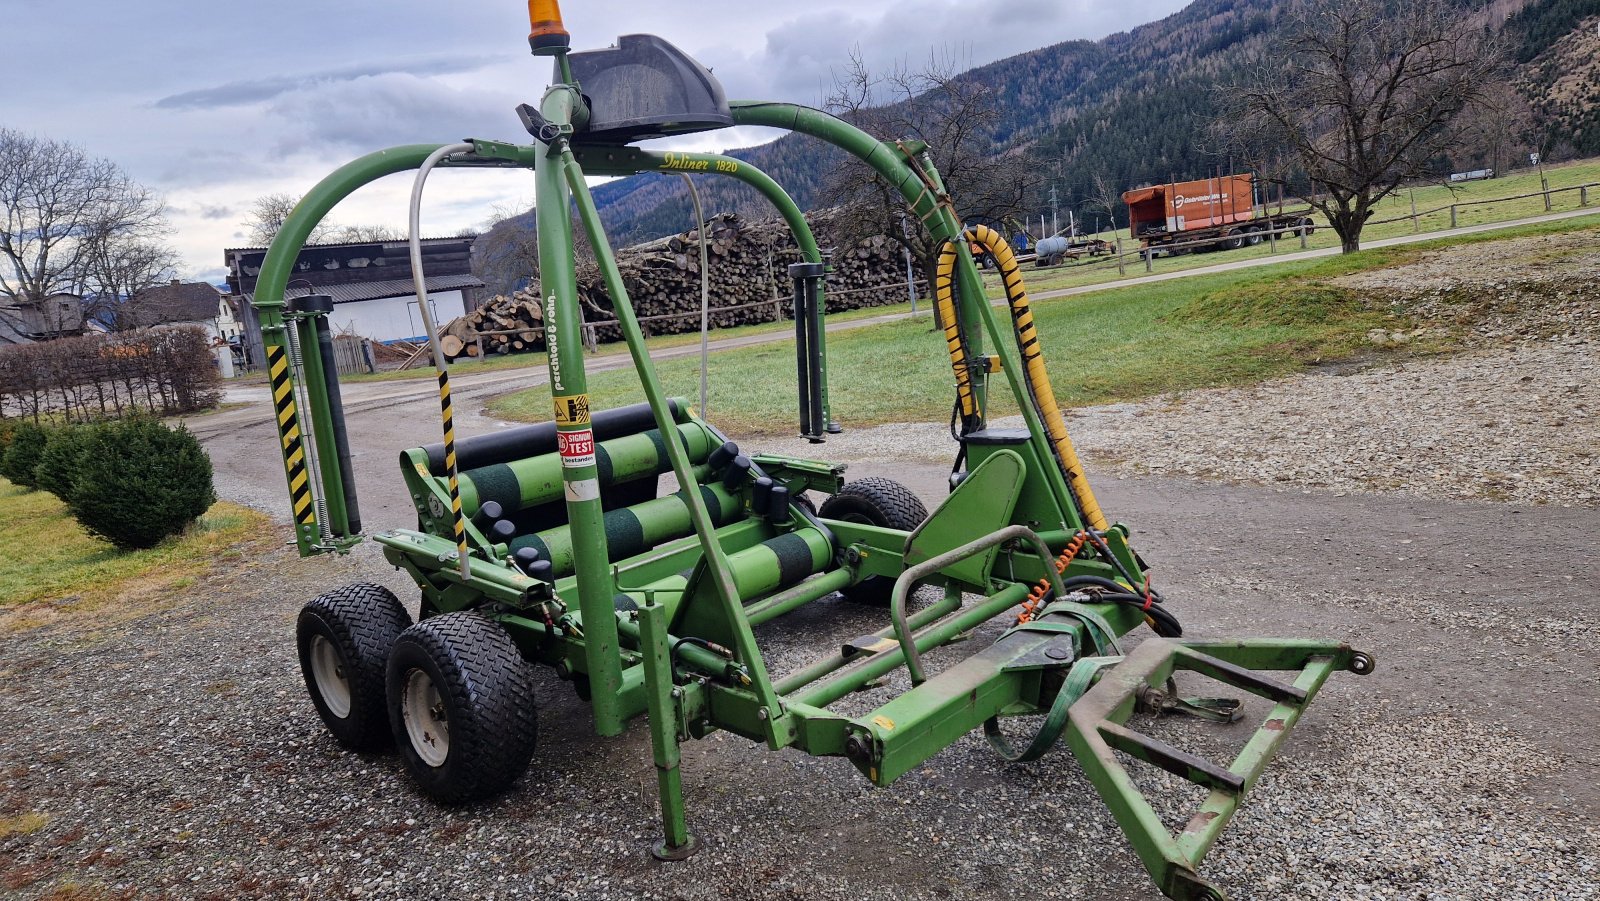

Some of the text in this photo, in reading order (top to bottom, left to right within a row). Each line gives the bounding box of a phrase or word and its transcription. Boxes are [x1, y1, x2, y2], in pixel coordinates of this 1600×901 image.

[659, 151, 738, 172] Inliner 1820
[547, 325, 557, 333] &
[548, 334, 564, 391] perchtold
[569, 433, 591, 442] SIGNUM
[569, 441, 592, 454] TEST
